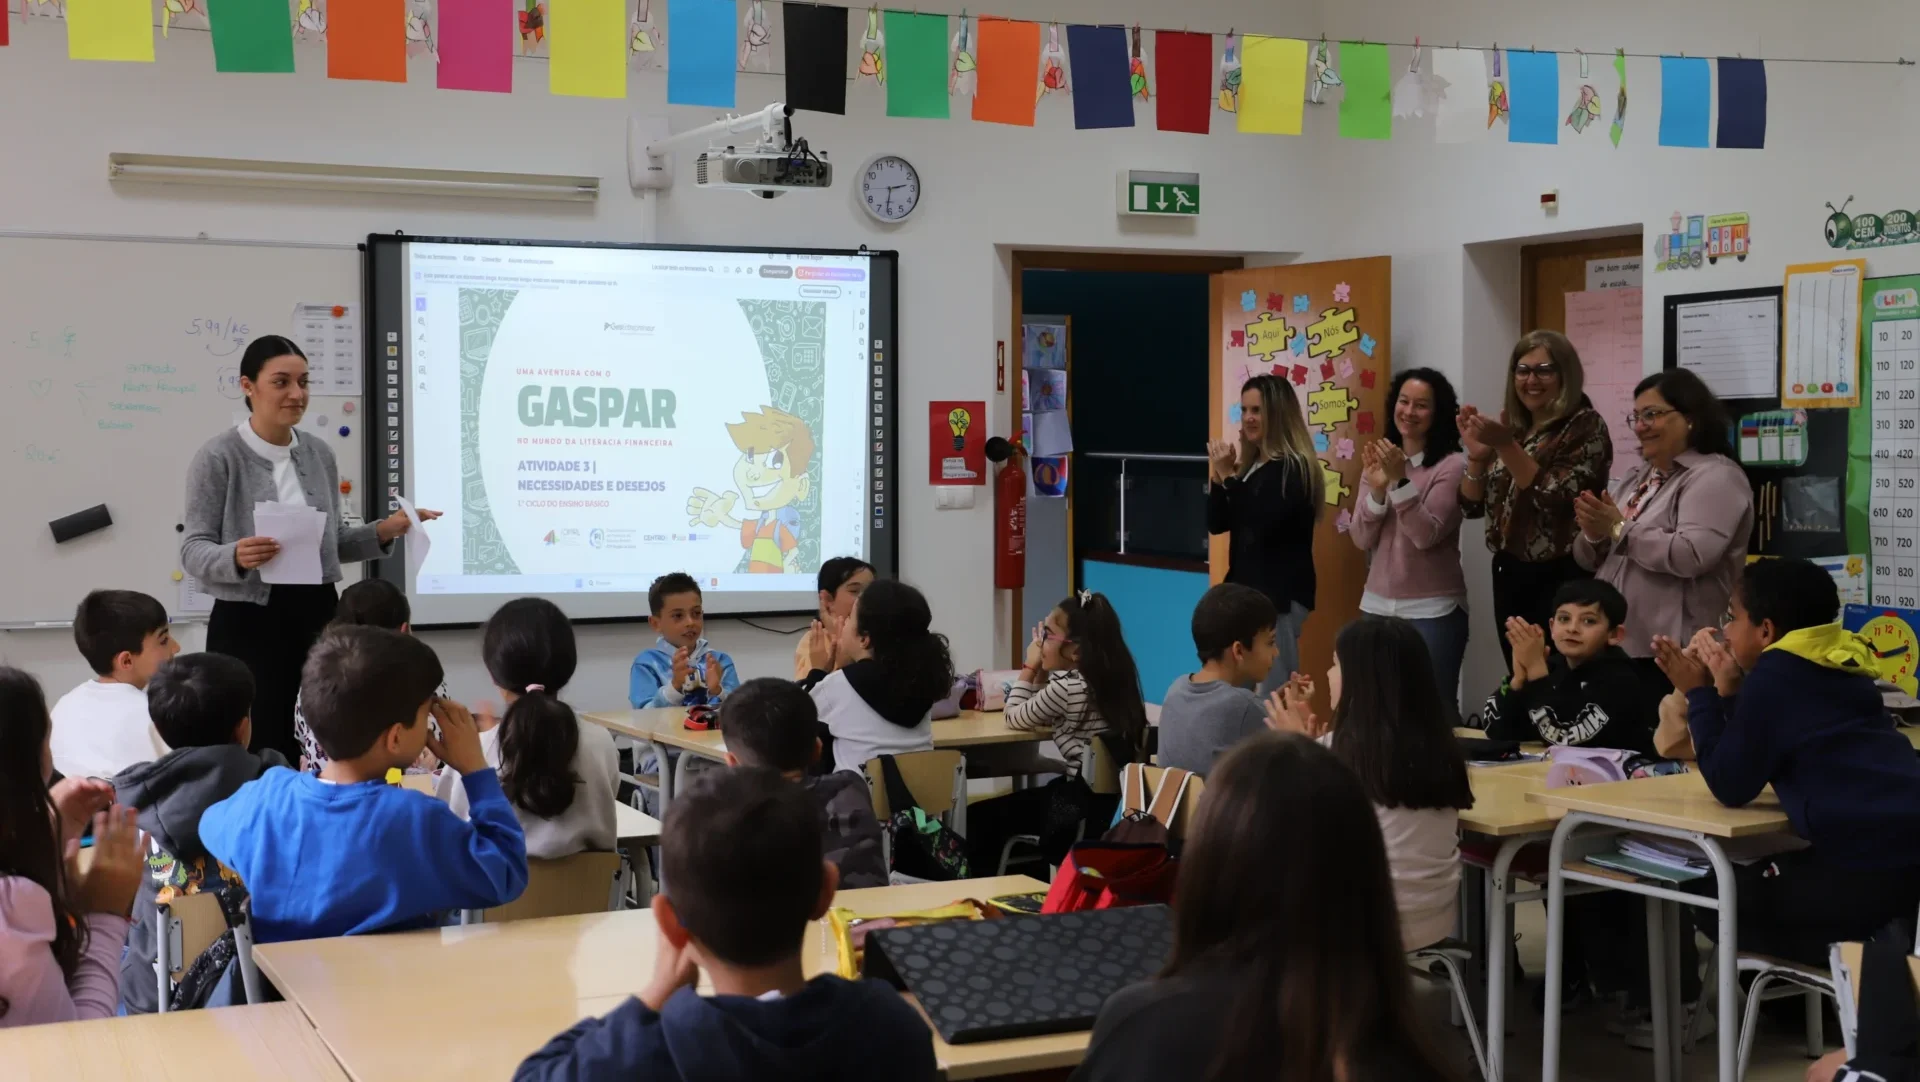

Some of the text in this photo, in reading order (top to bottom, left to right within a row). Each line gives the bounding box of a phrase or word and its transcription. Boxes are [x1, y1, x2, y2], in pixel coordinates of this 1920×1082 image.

[886, 160, 894, 168] 12
[907, 172, 912, 180] 2
[877, 204, 882, 212] 7
[1856, 216, 1875, 227] 100
[1887, 213, 1907, 224] 200
[1854, 227, 1875, 238] CEM
[1884, 222, 1911, 235] DUZENTOS
[1712, 229, 1741, 240] C D U
[1607, 263, 1619, 271] bom
[1263, 328, 1280, 341] Aqui
[1324, 325, 1340, 338] Nós
[1879, 330, 1912, 342] 10 20
[1876, 360, 1914, 371] 110 120
[1876, 389, 1915, 400] 210 220
[517, 385, 676, 429] GASPAR
[1320, 400, 1346, 410] Somos
[1876, 419, 1915, 429] 310 320
[625, 439, 673, 447] FINANCEIRA
[1875, 449, 1913, 459] 410 420
[518, 460, 580, 471] ATIVIDADE
[584, 461, 590, 472] 3
[518, 480, 666, 492] NECESSIDADES E DESEJOS
[1875, 478, 1914, 488] 510 520
[1873, 508, 1913, 518] 610 620
[1875, 537, 1912, 548] 710 720
[1876, 566, 1913, 577] 810 820
[1875, 595, 1915, 607] 910 920
[1874, 627, 1881, 636] 11
[1885, 625, 1893, 634] 12
[1898, 630, 1902, 638] 1
[1905, 654, 1911, 662] 3
[1900, 666, 1906, 674] 4
[1891, 675, 1897, 683] 5
